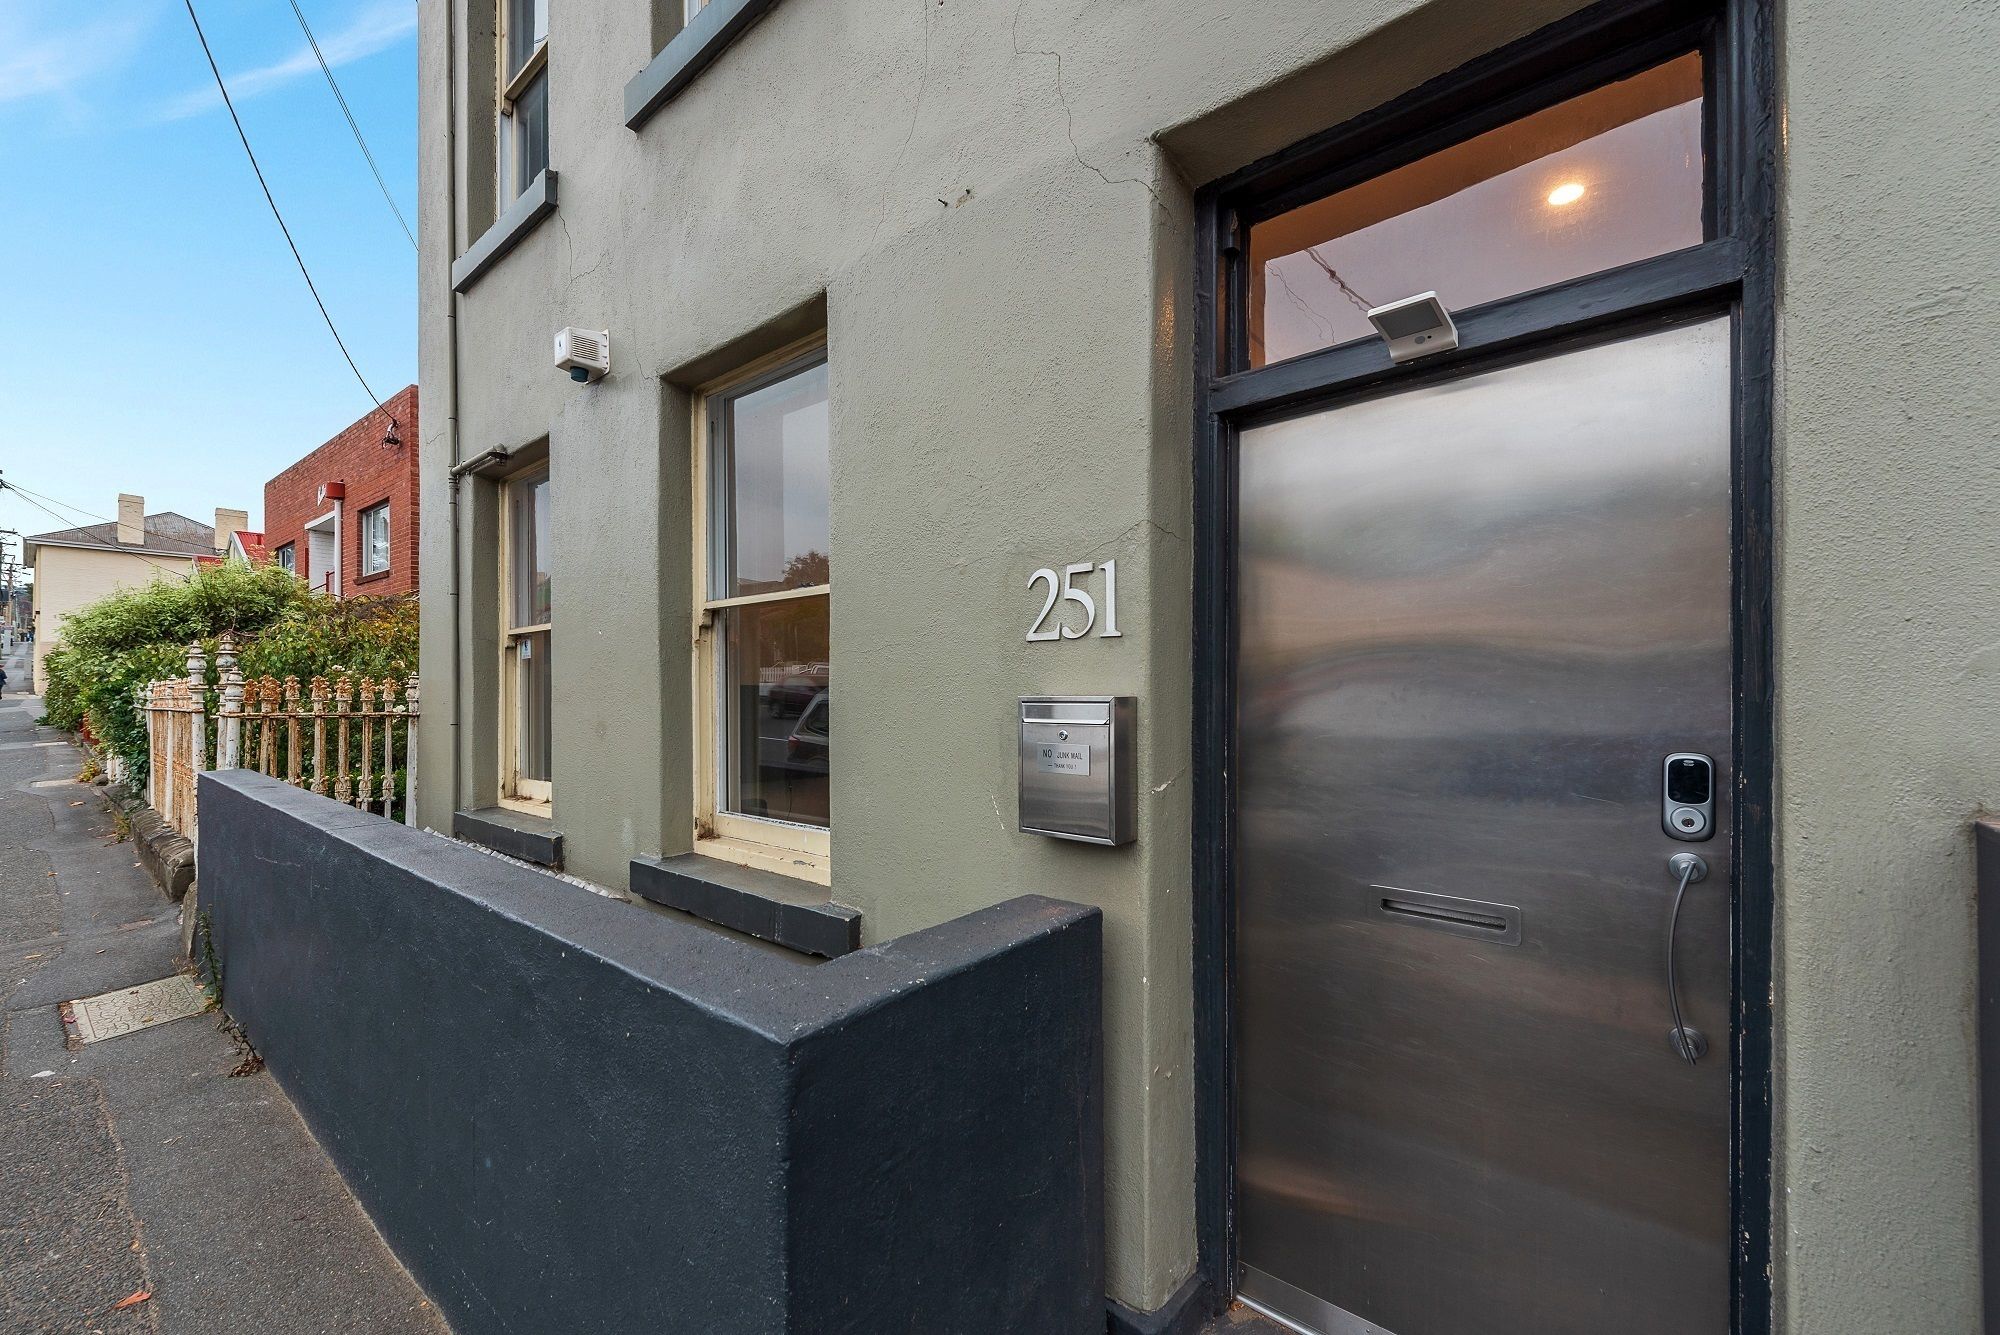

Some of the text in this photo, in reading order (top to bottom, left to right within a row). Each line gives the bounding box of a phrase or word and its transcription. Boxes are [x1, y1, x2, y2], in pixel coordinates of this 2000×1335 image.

[1026, 559, 1122, 642] 251
[1042, 748, 1082, 760] NO JUNK MAIL
